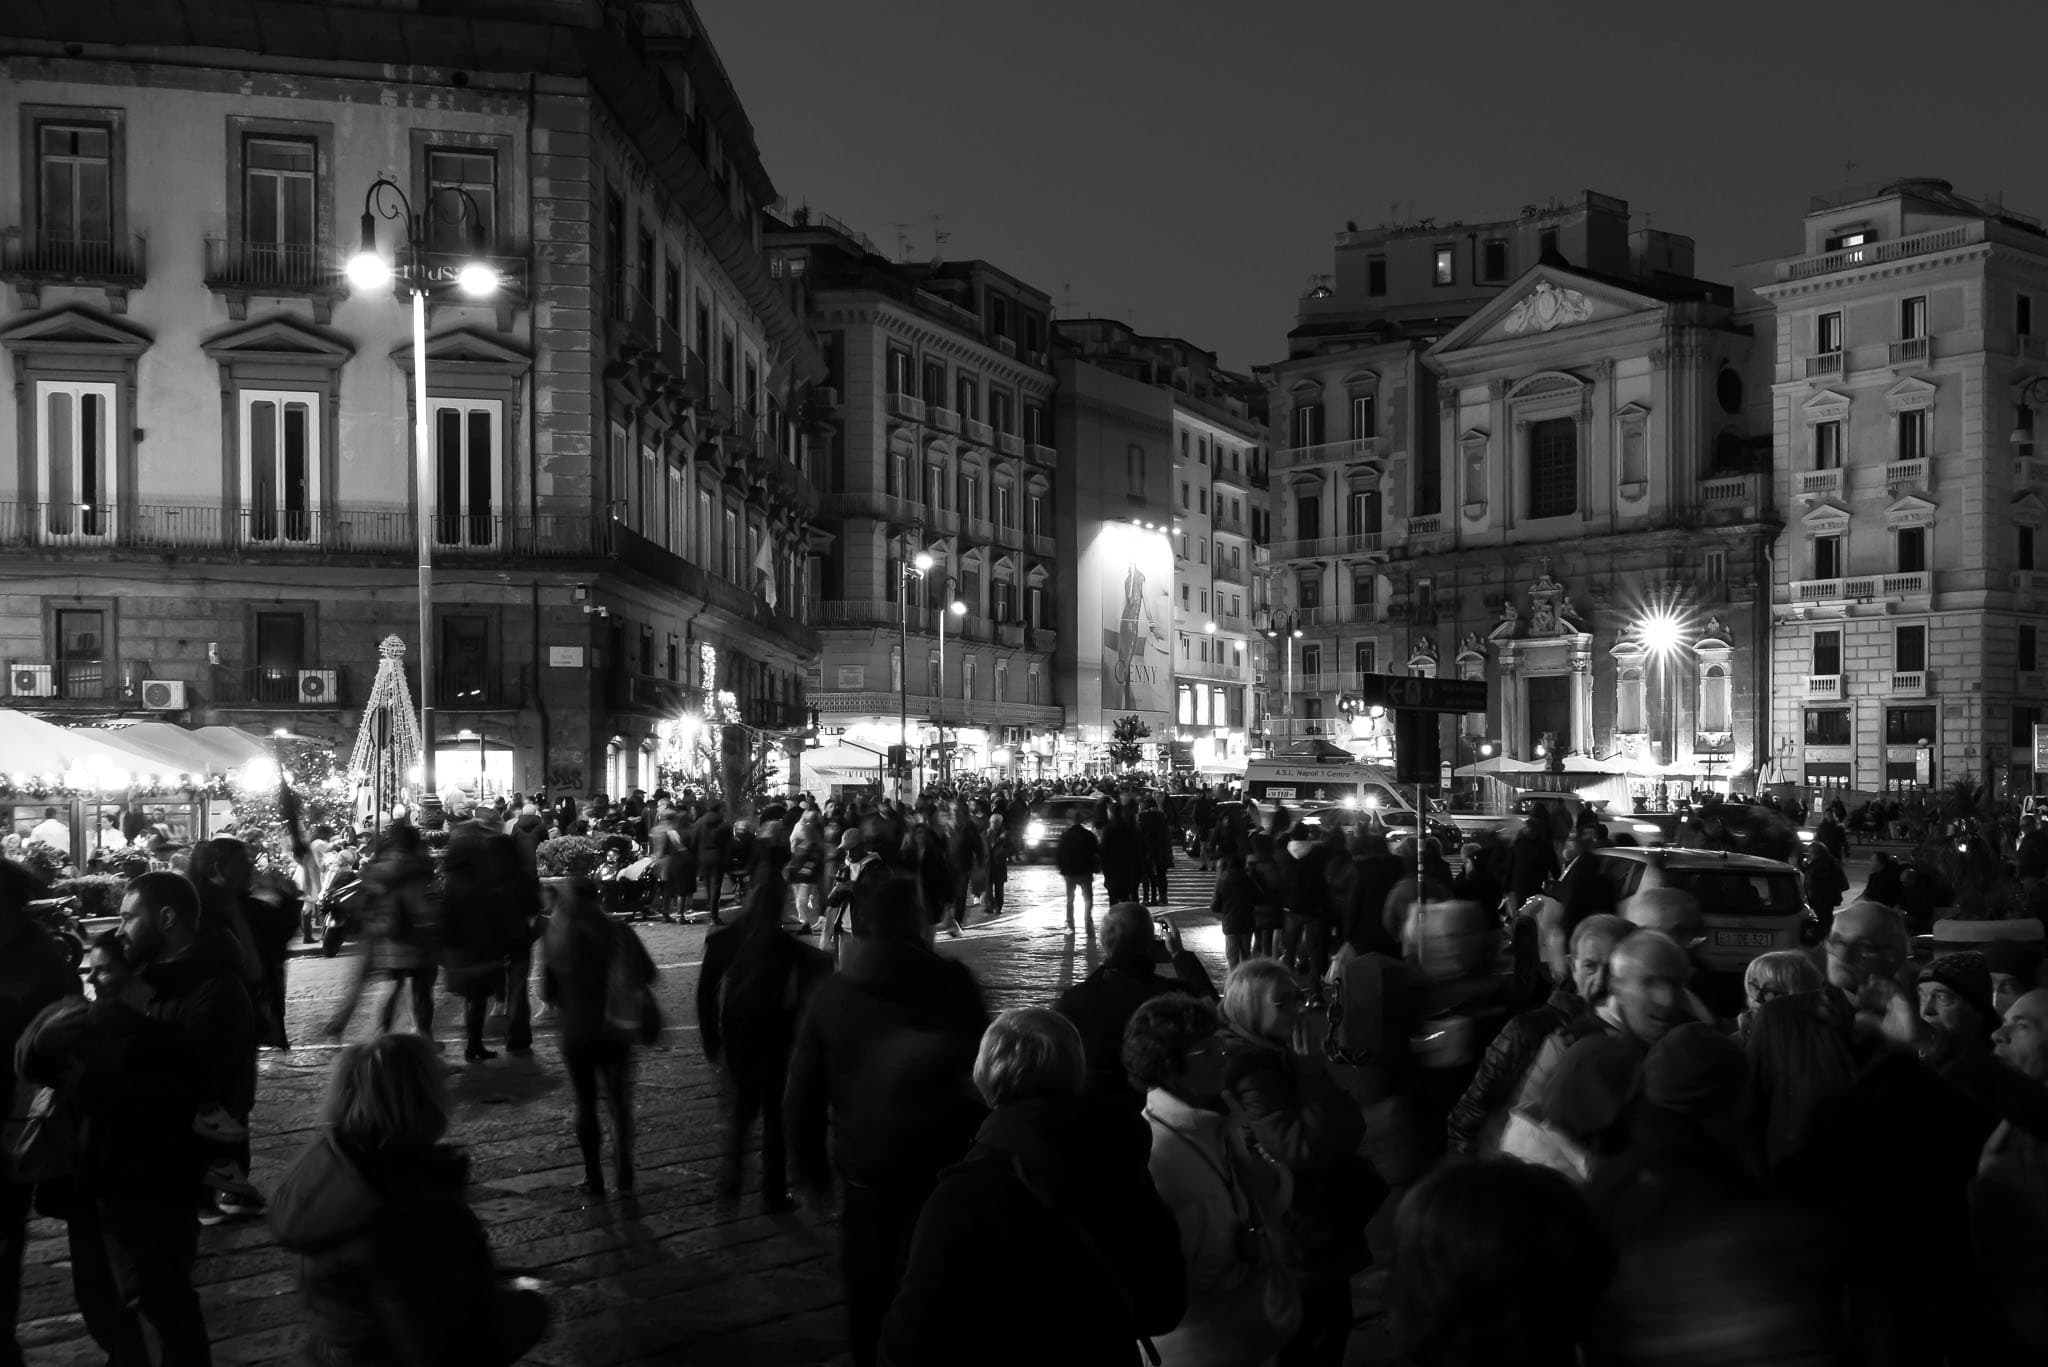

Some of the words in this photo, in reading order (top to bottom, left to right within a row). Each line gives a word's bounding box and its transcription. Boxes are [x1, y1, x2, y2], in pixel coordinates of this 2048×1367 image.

[1115, 659, 1157, 685] GENNY
[1296, 769, 1319, 778] Napoli
[1327, 770, 1351, 778] Centro
